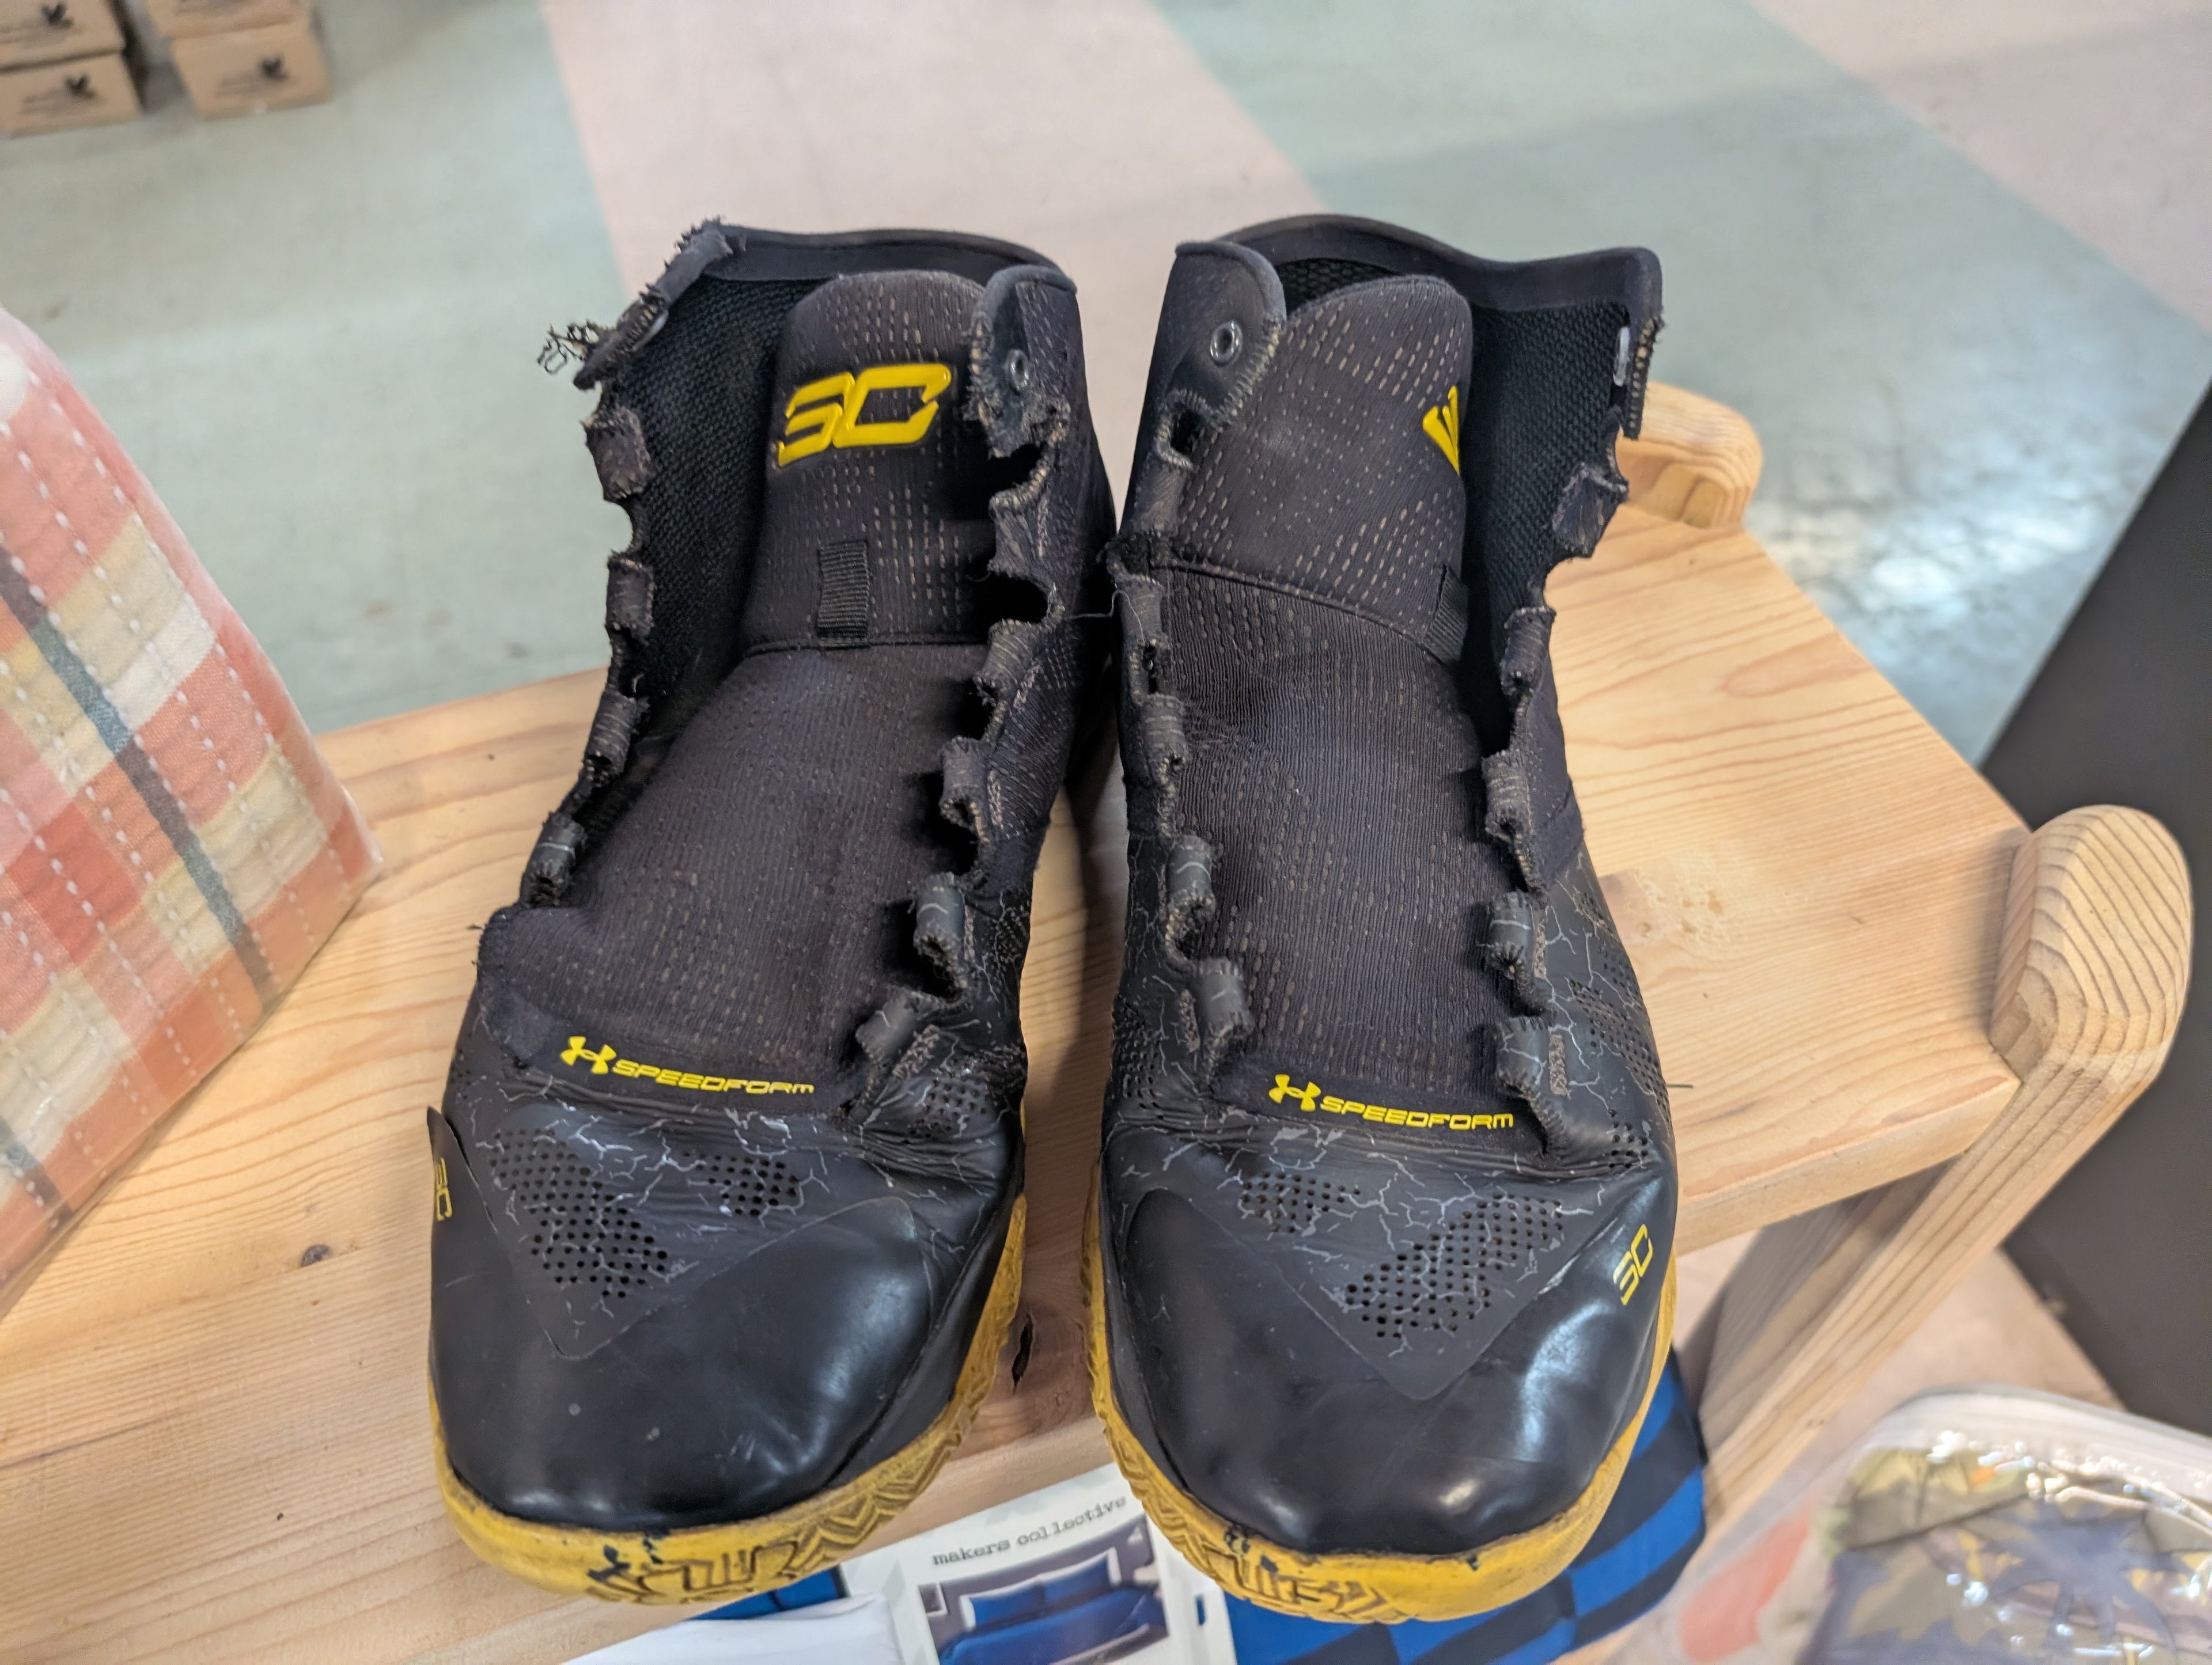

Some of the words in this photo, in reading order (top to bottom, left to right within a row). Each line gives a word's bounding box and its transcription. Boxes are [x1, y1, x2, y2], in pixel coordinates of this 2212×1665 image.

[612, 1059, 815, 1094] SPEEDFORM
[1320, 1095, 1514, 1131] SPEEDFORM
[932, 1538, 1011, 1565] makers
[1016, 1497, 1127, 1546] collective
